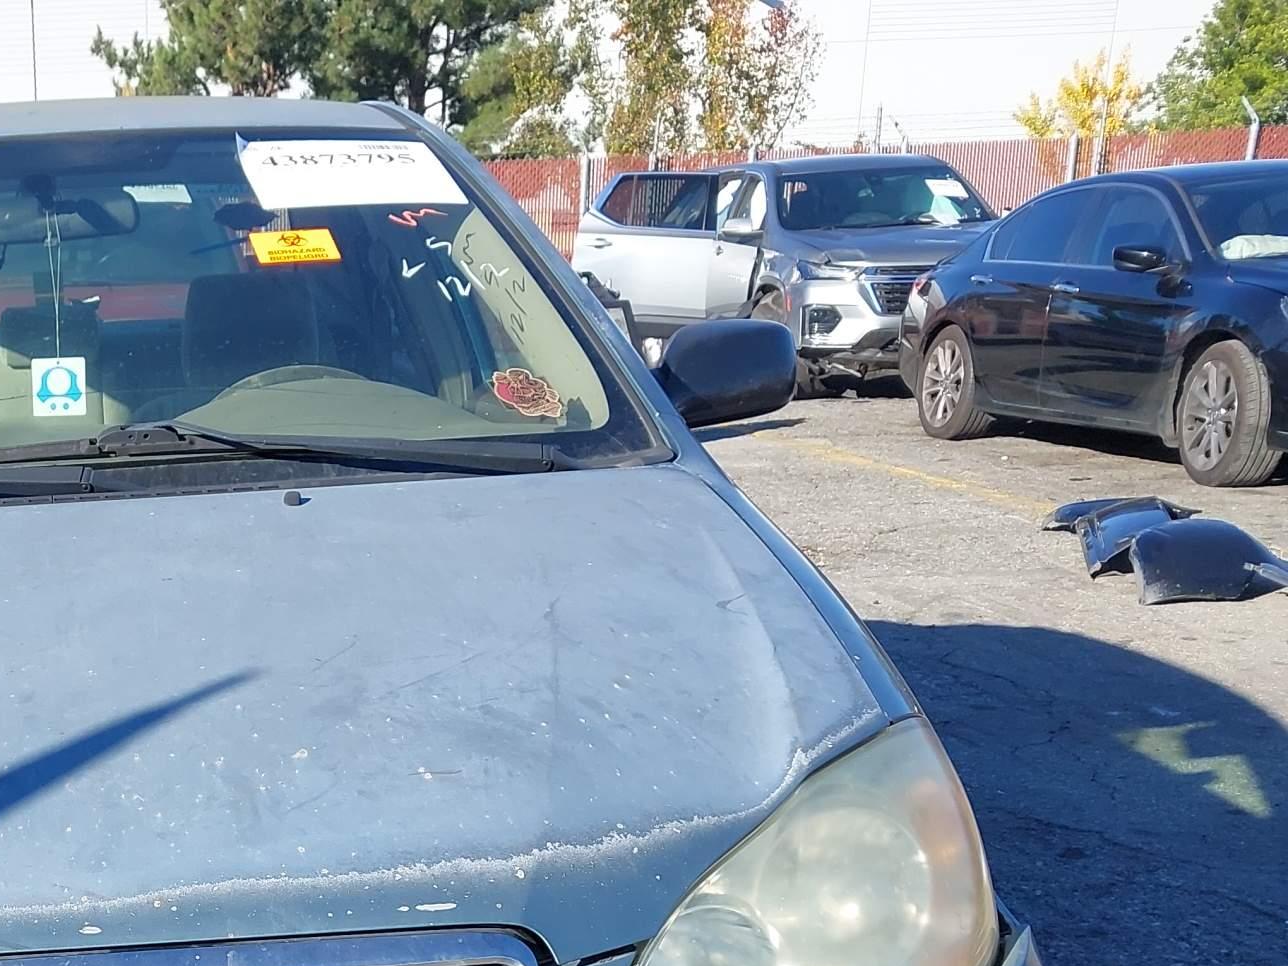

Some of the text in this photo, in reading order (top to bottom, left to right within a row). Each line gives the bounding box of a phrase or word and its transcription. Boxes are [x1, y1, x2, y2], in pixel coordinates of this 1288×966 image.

[261, 153, 416, 167] 43873795
[267, 247, 326, 256] BIOHAZARD
[269, 253, 329, 262] BIOPELIGRO
